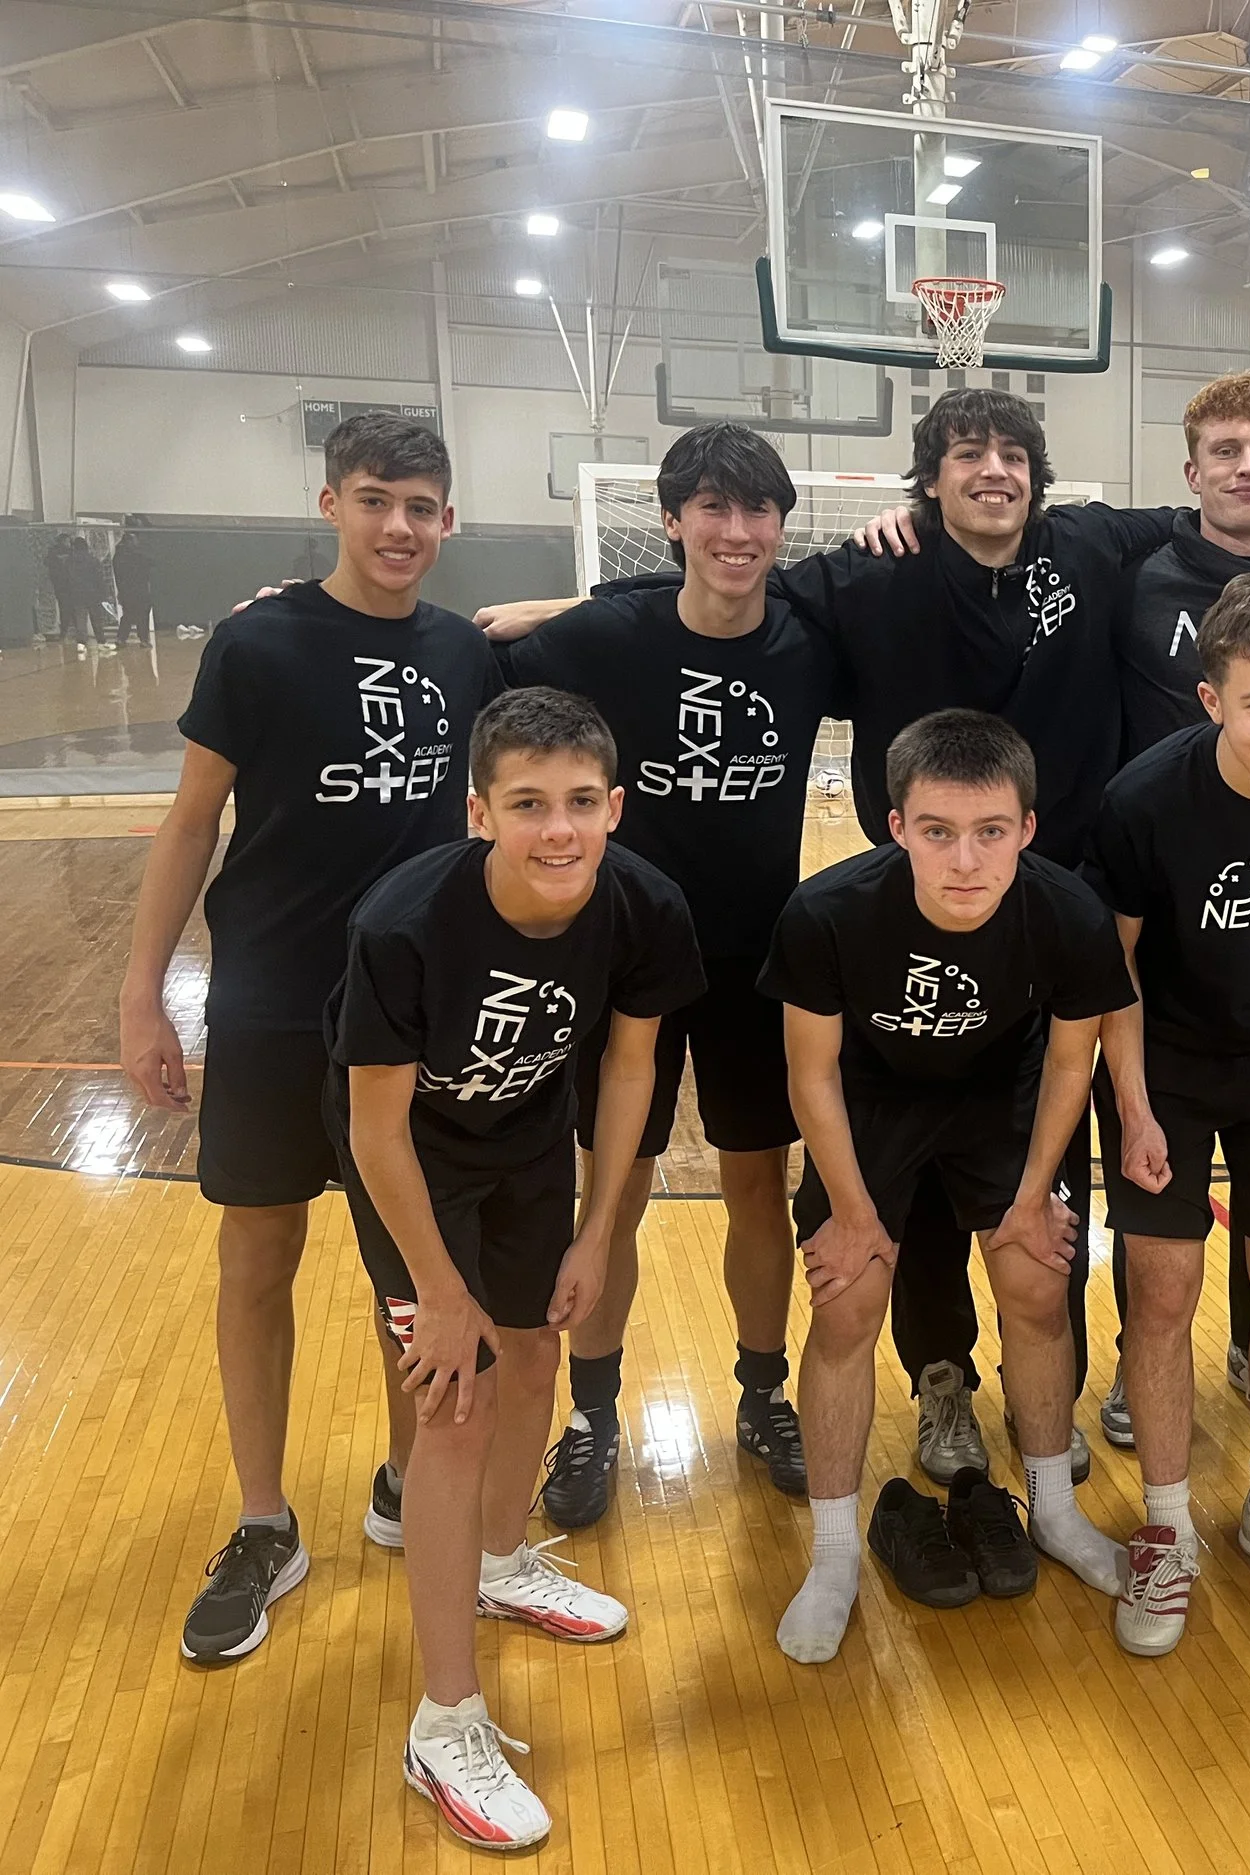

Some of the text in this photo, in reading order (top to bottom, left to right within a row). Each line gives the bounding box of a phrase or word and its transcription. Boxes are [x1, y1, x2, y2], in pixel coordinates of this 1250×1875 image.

[304, 402, 335, 413] HOME
[403, 407, 436, 418] GUEST
[730, 753, 788, 764] ACADEMY
